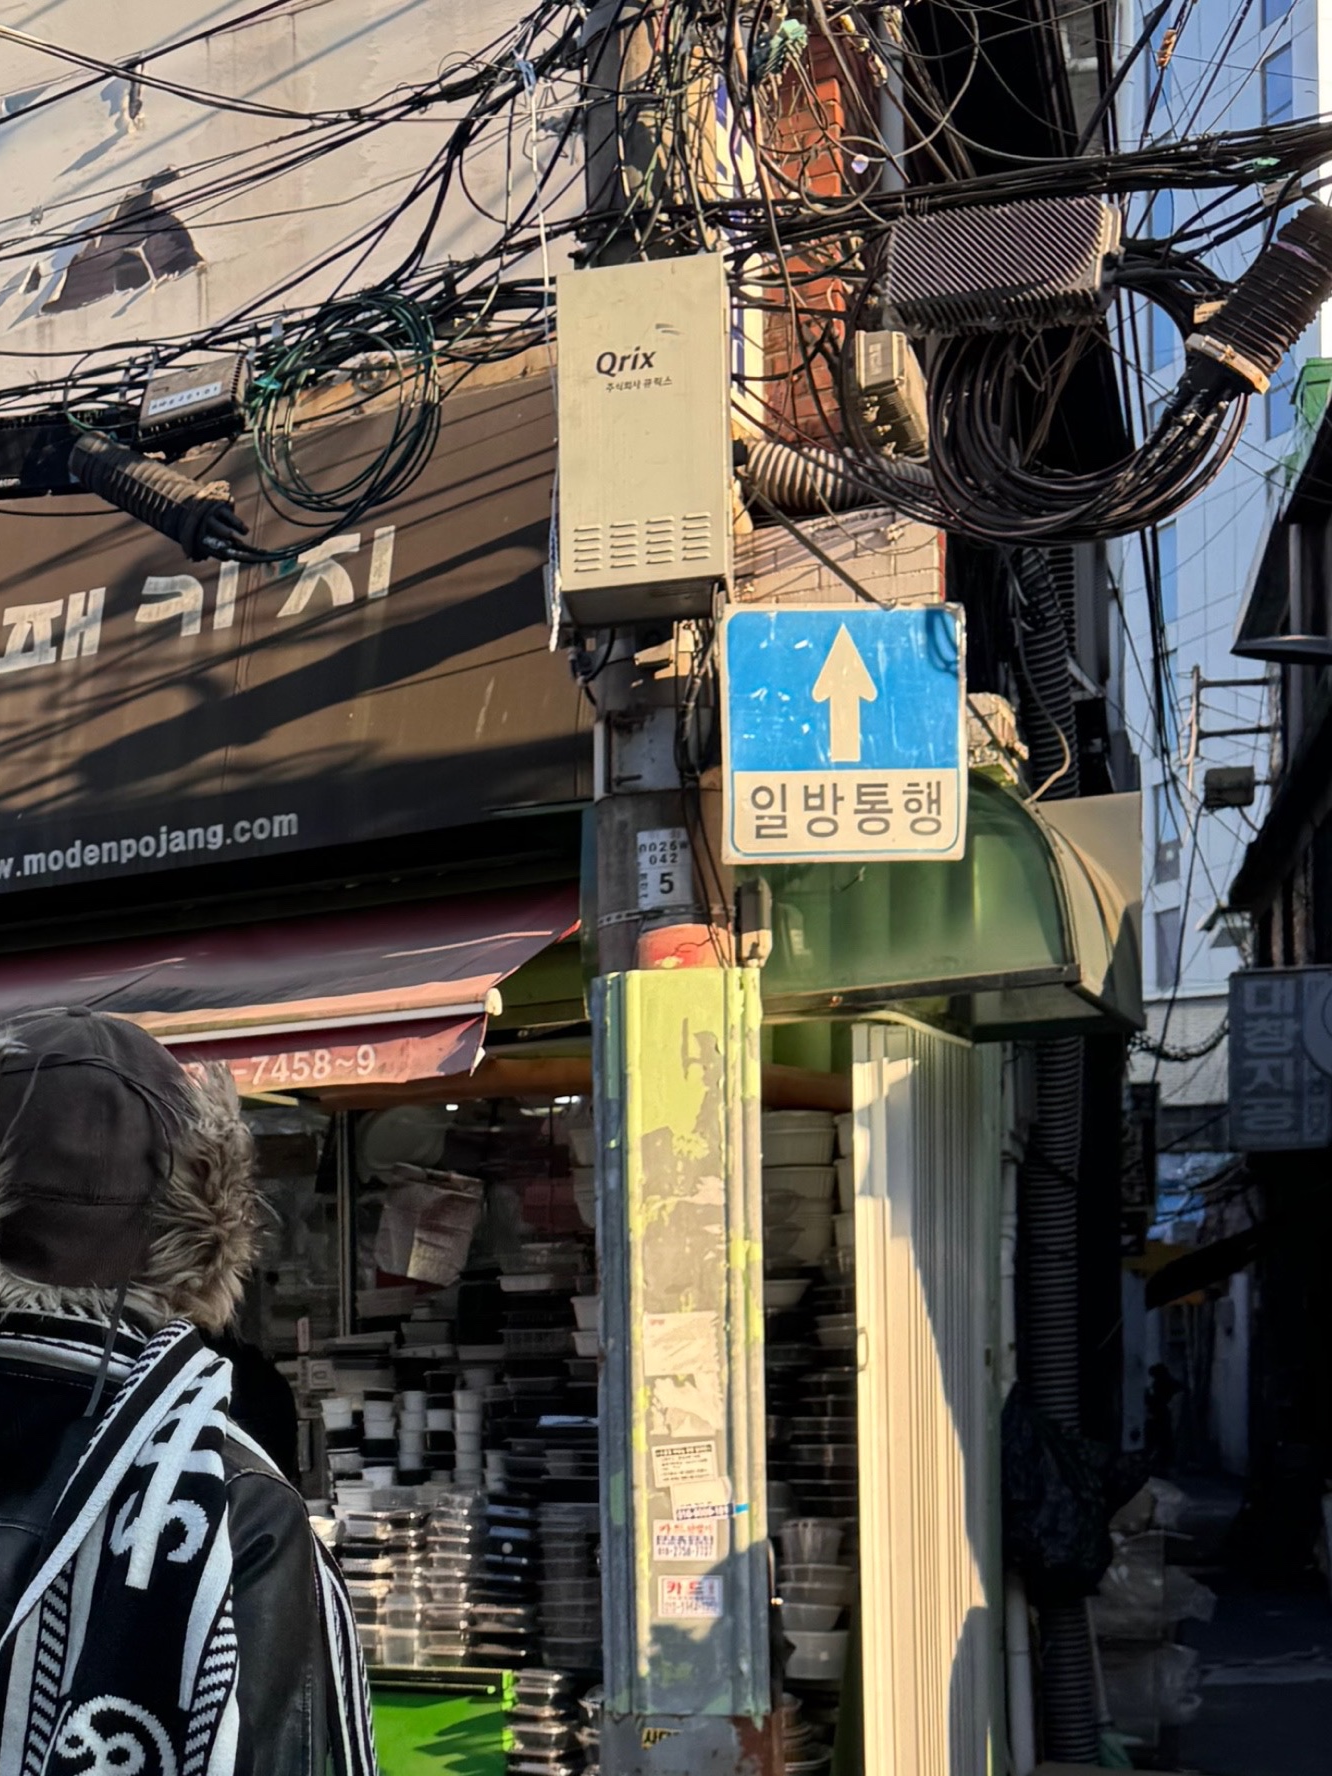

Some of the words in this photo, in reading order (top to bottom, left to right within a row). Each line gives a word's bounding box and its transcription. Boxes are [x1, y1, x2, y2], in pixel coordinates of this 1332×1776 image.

[595, 346, 657, 378] Qrix
[749, 781, 943, 840] 일방통행
[649, 852, 678, 866] 042
[659, 872, 675, 895] 5
